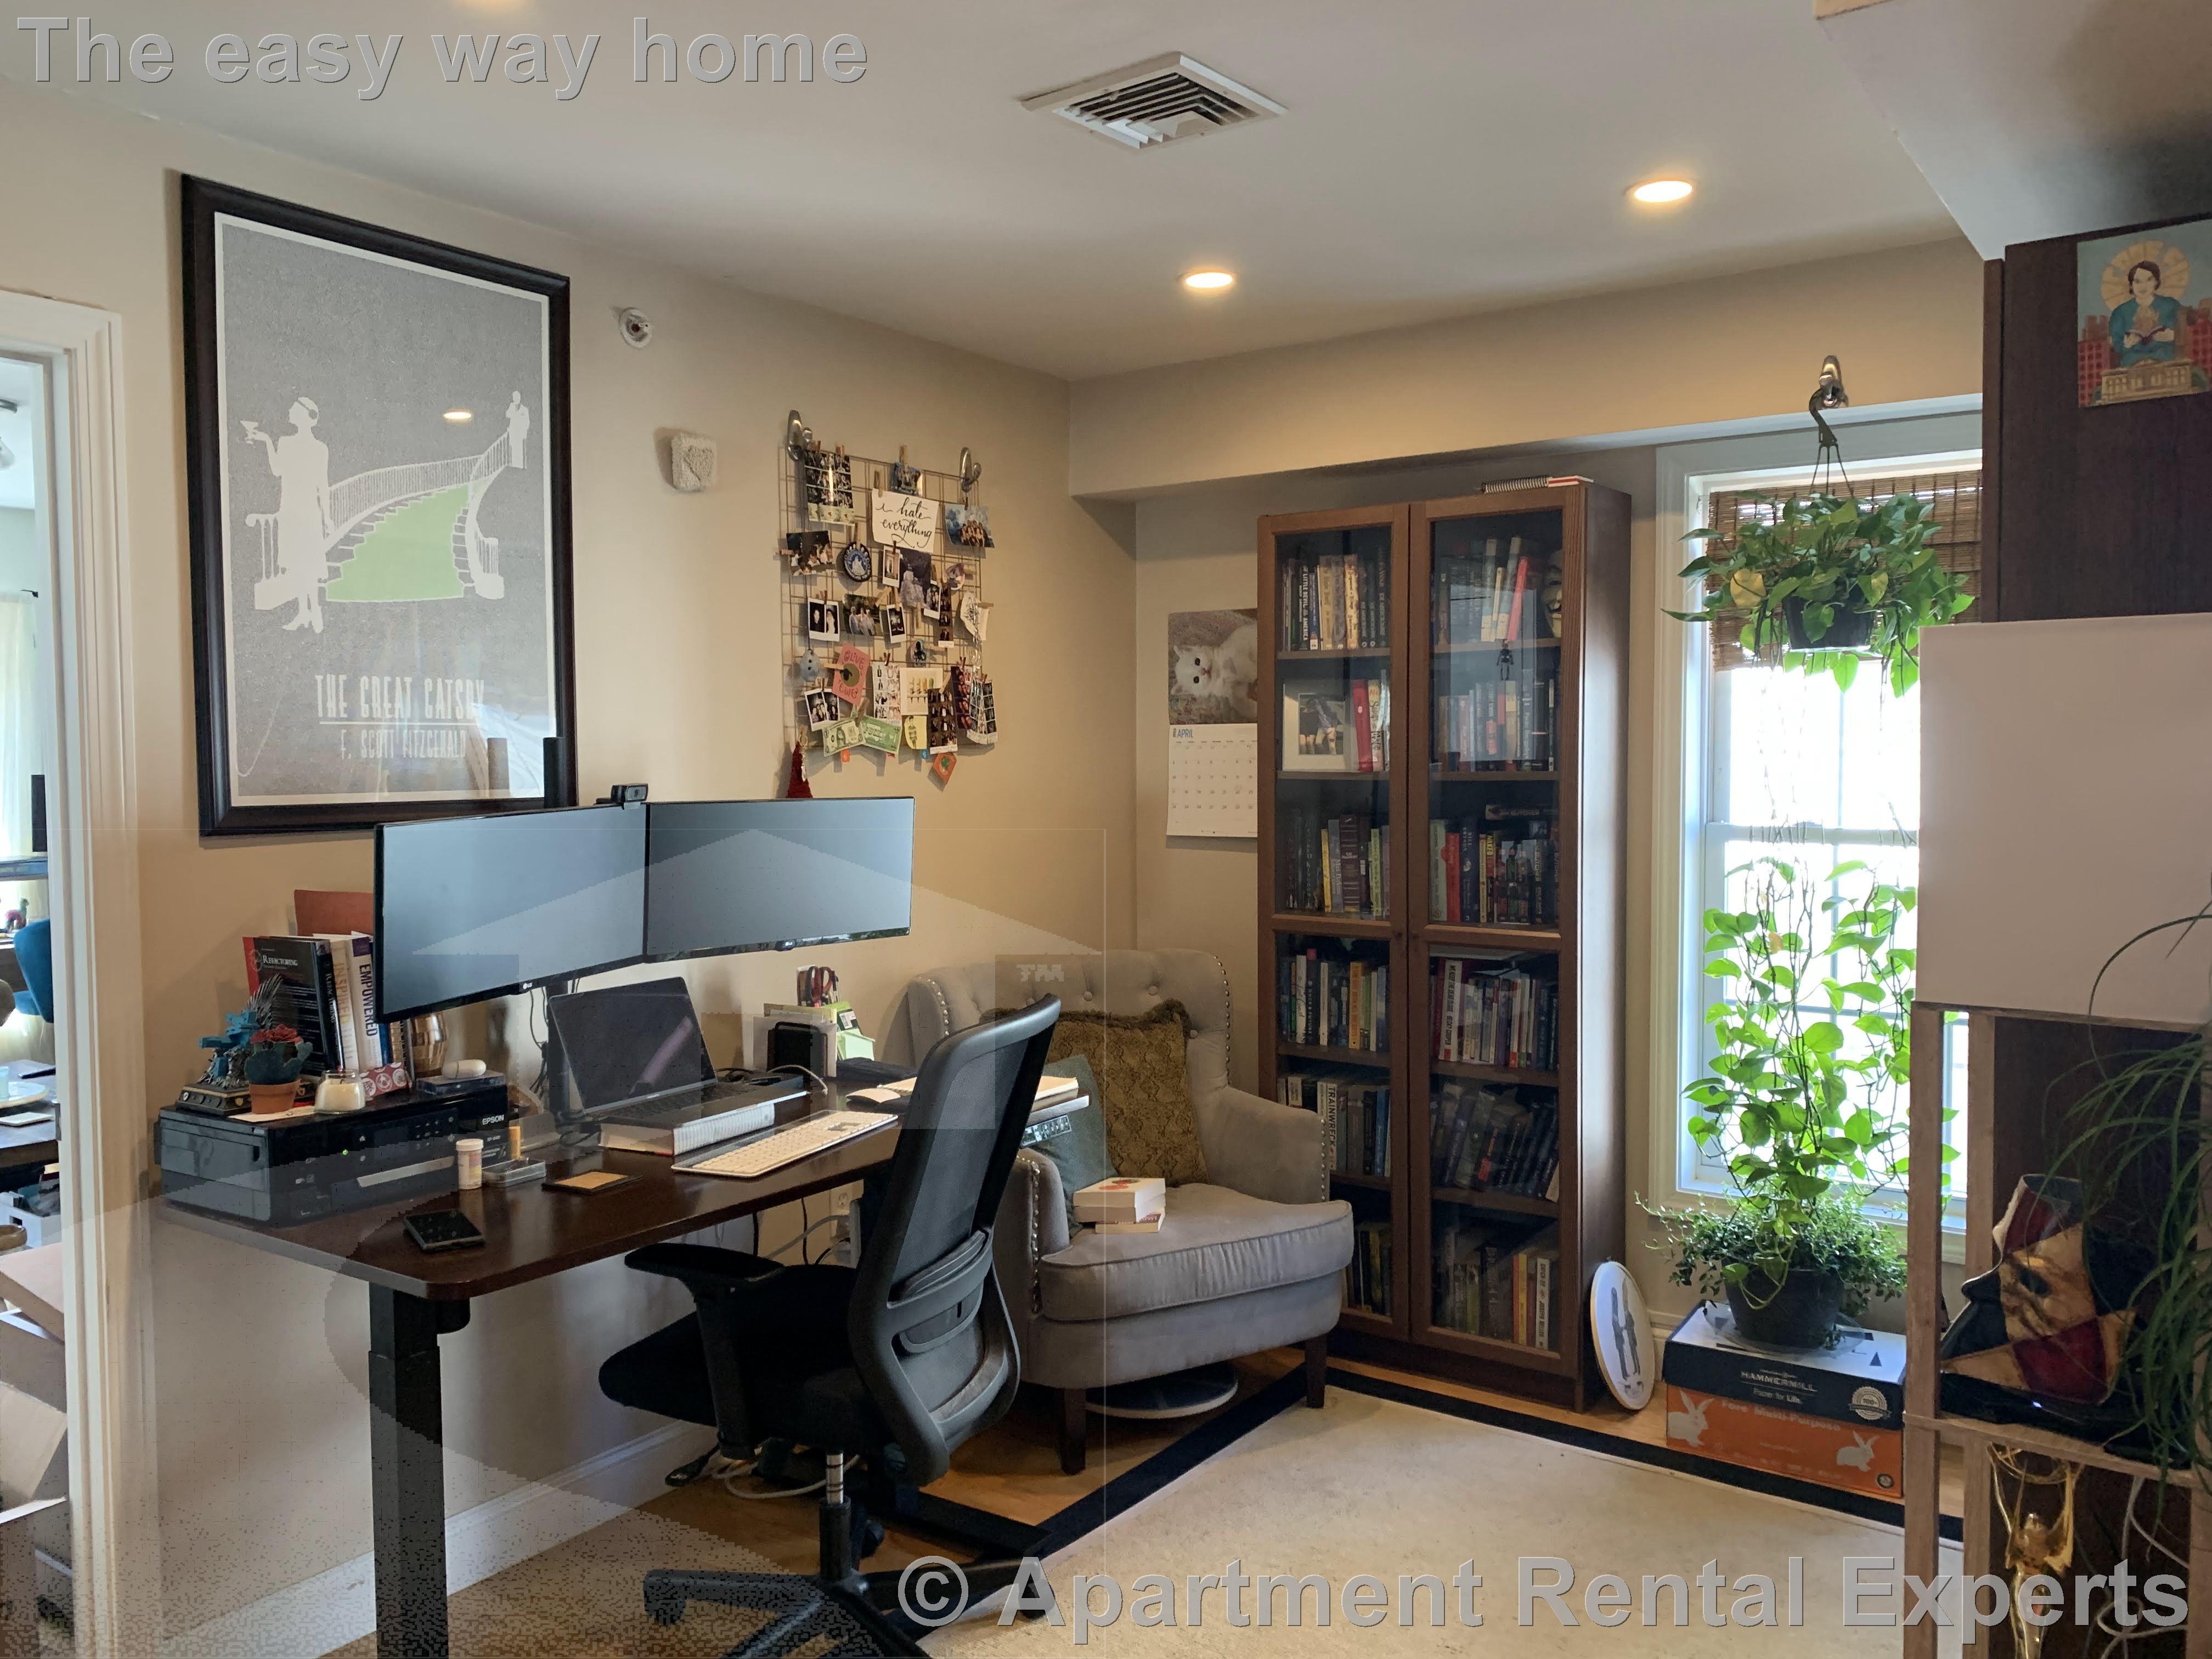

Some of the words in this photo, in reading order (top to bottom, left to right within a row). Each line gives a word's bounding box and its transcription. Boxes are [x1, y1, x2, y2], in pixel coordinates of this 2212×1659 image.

[896, 496, 932, 520] hate
[880, 518, 933, 549] everything
[844, 650, 865, 670] OLIVE
[315, 675, 348, 718] THE
[360, 676, 413, 719] GREAT
[424, 678, 484, 720] GATSBY
[361, 730, 394, 758] SCOTT
[403, 730, 466, 759] FITZGERALD
[1177, 729, 1194, 738] APRIL
[335, 963, 352, 1025] INSPIRED
[359, 963, 378, 1036] EMPOWERED
[482, 1114, 505, 1125] EPSON
[1328, 1086, 1336, 1146] TRAINWRECK
[1740, 1370, 1818, 1392] HAMMERMILL
